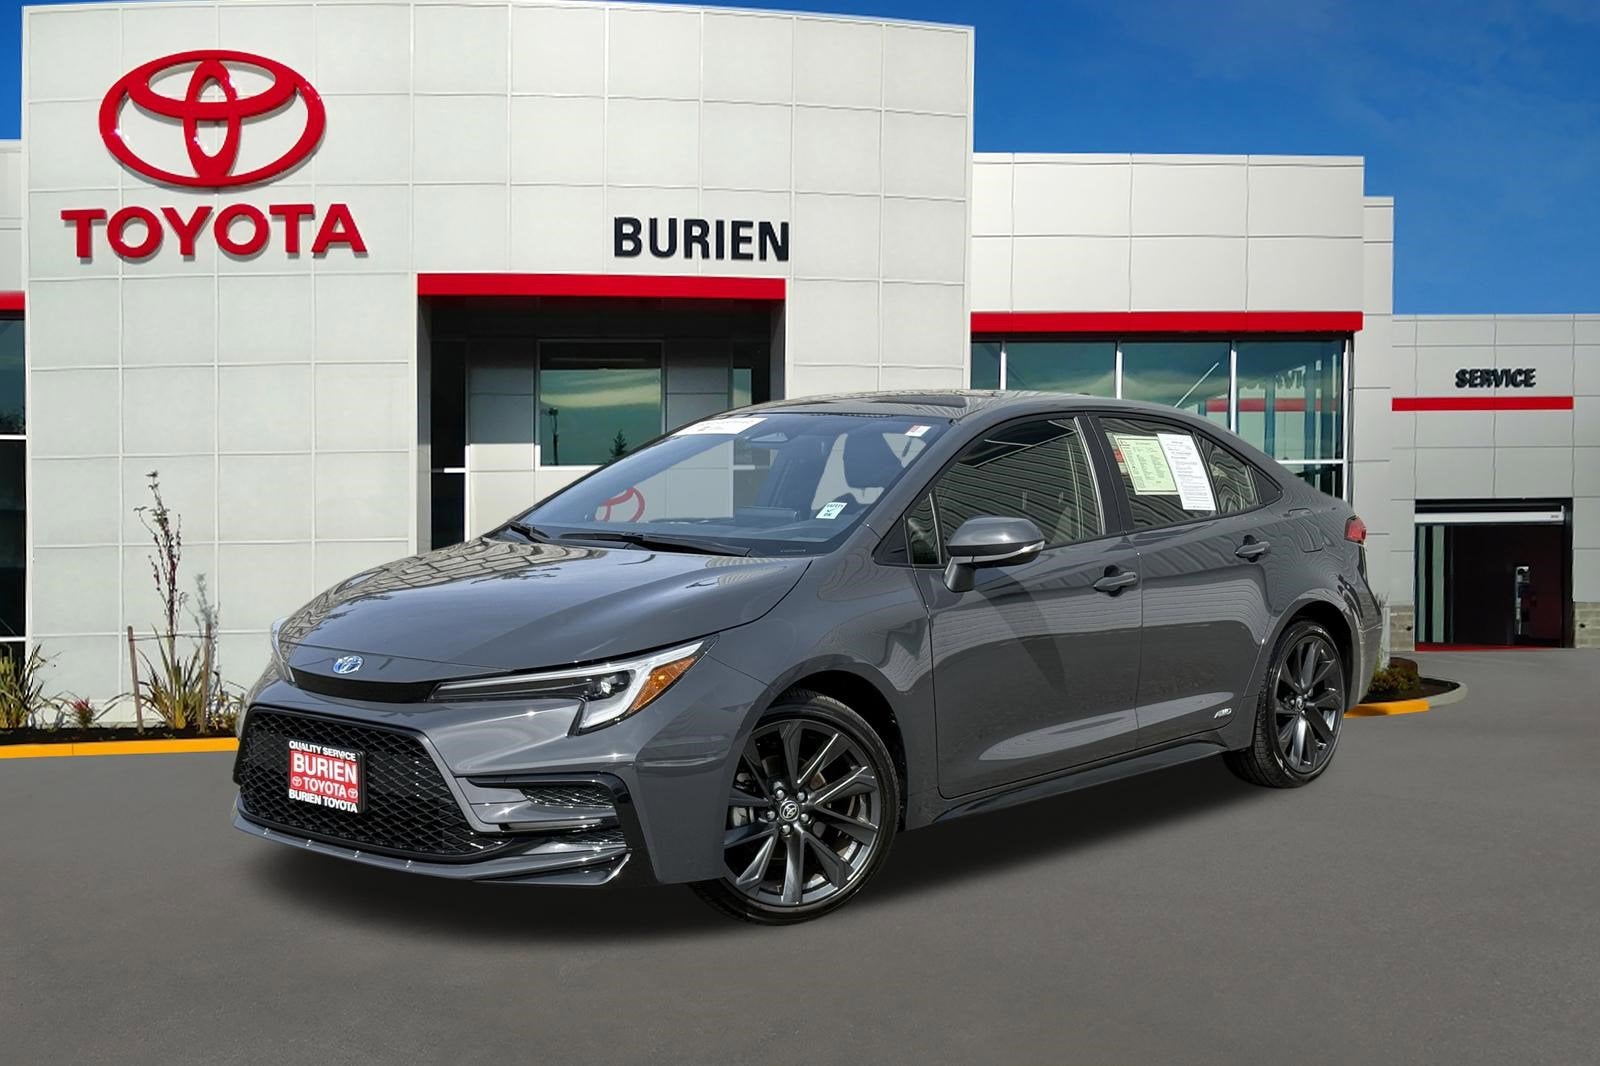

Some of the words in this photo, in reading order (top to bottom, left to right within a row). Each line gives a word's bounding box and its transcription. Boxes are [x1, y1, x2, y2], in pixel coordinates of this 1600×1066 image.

[61, 203, 367, 258] TOYOTA
[614, 216, 789, 261] BURIEN
[1455, 368, 1536, 388] SERVICE
[289, 740, 321, 754] QUALITY
[322, 747, 356, 761] SERVICE
[293, 753, 357, 784] BURIEN
[303, 776, 347, 799] TOYOTA
[289, 788, 321, 805] BURIEN
[322, 796, 358, 813] TOYOTA
